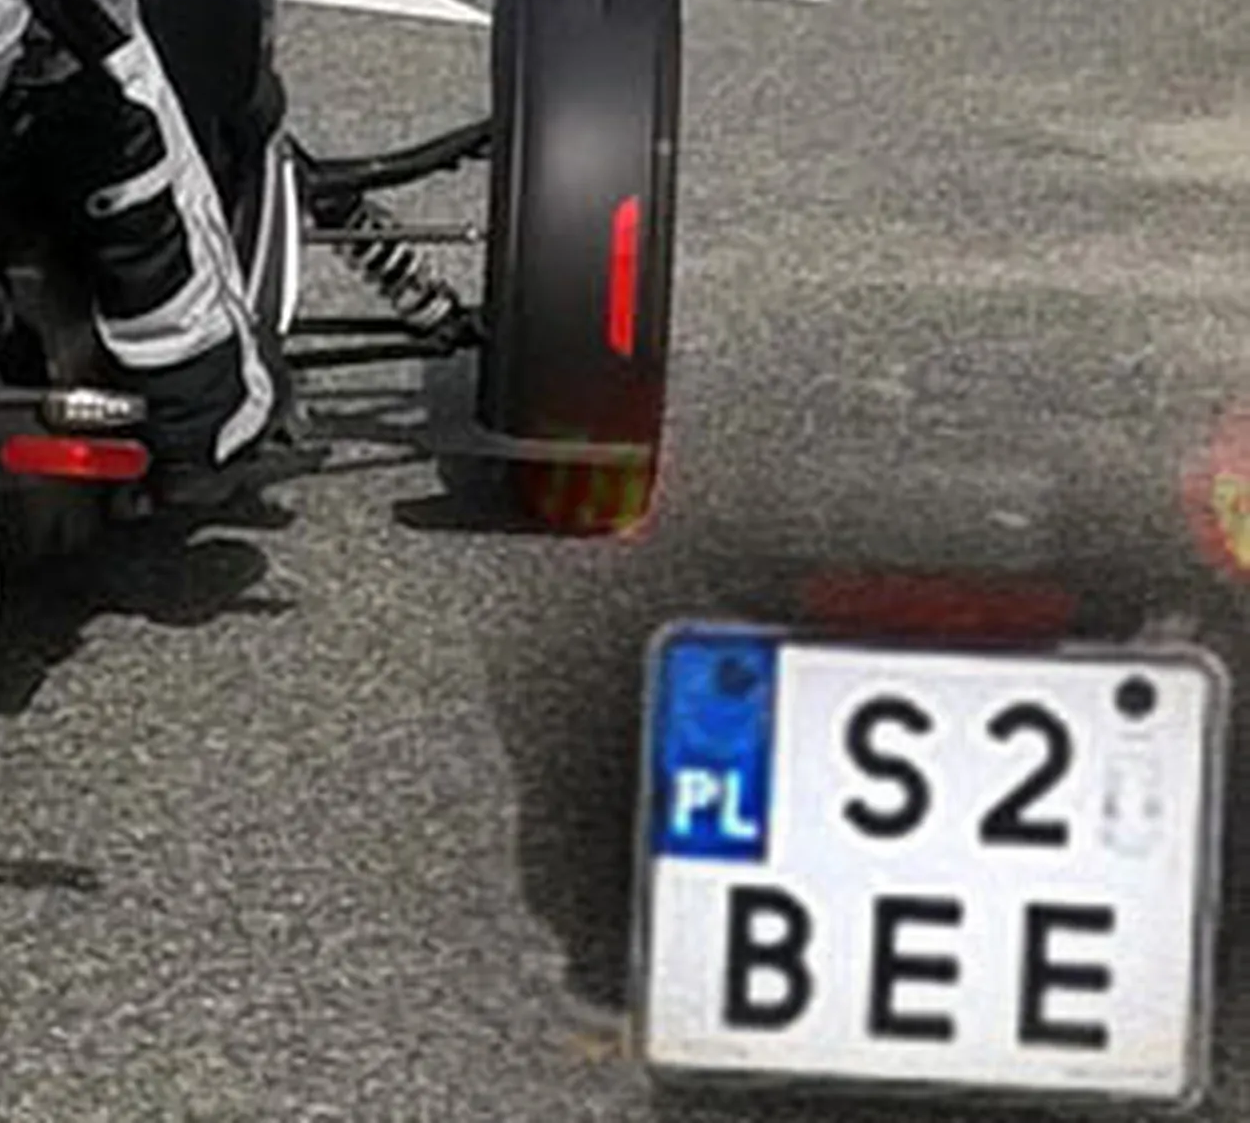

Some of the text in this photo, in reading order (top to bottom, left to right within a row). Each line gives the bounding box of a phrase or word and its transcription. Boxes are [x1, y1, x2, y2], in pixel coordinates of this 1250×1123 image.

[672, 768, 758, 839] PL
[842, 694, 1073, 848] S2
[720, 884, 1116, 1050] BEE
